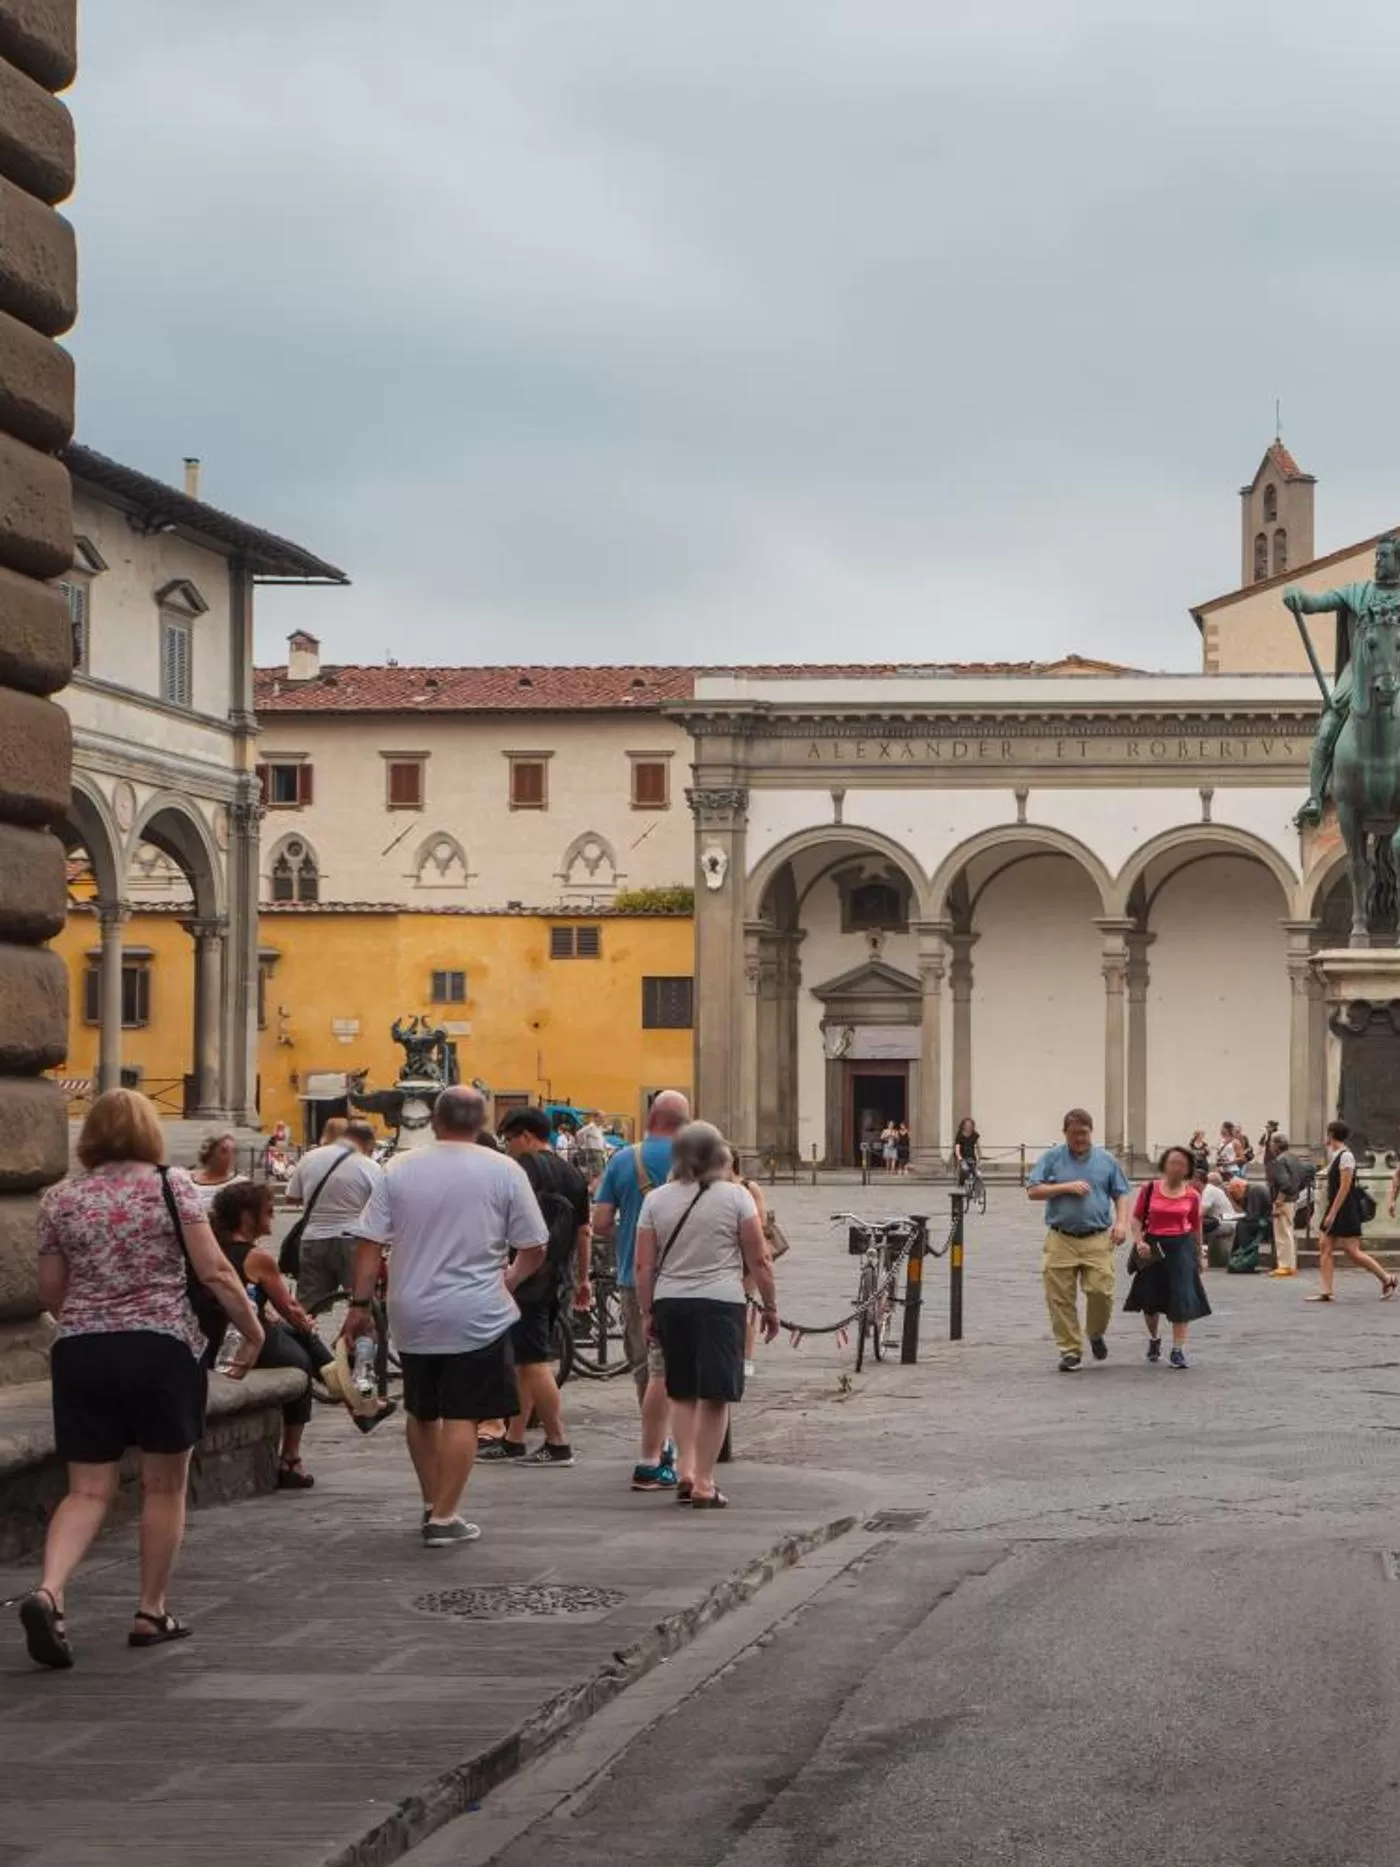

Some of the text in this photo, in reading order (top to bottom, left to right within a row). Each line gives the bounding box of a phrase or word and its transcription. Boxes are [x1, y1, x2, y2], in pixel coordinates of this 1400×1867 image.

[807, 740, 1015, 760] ALEXANDER
[1056, 740, 1091, 759] ET
[1126, 739, 1294, 760] ROBERTVS
